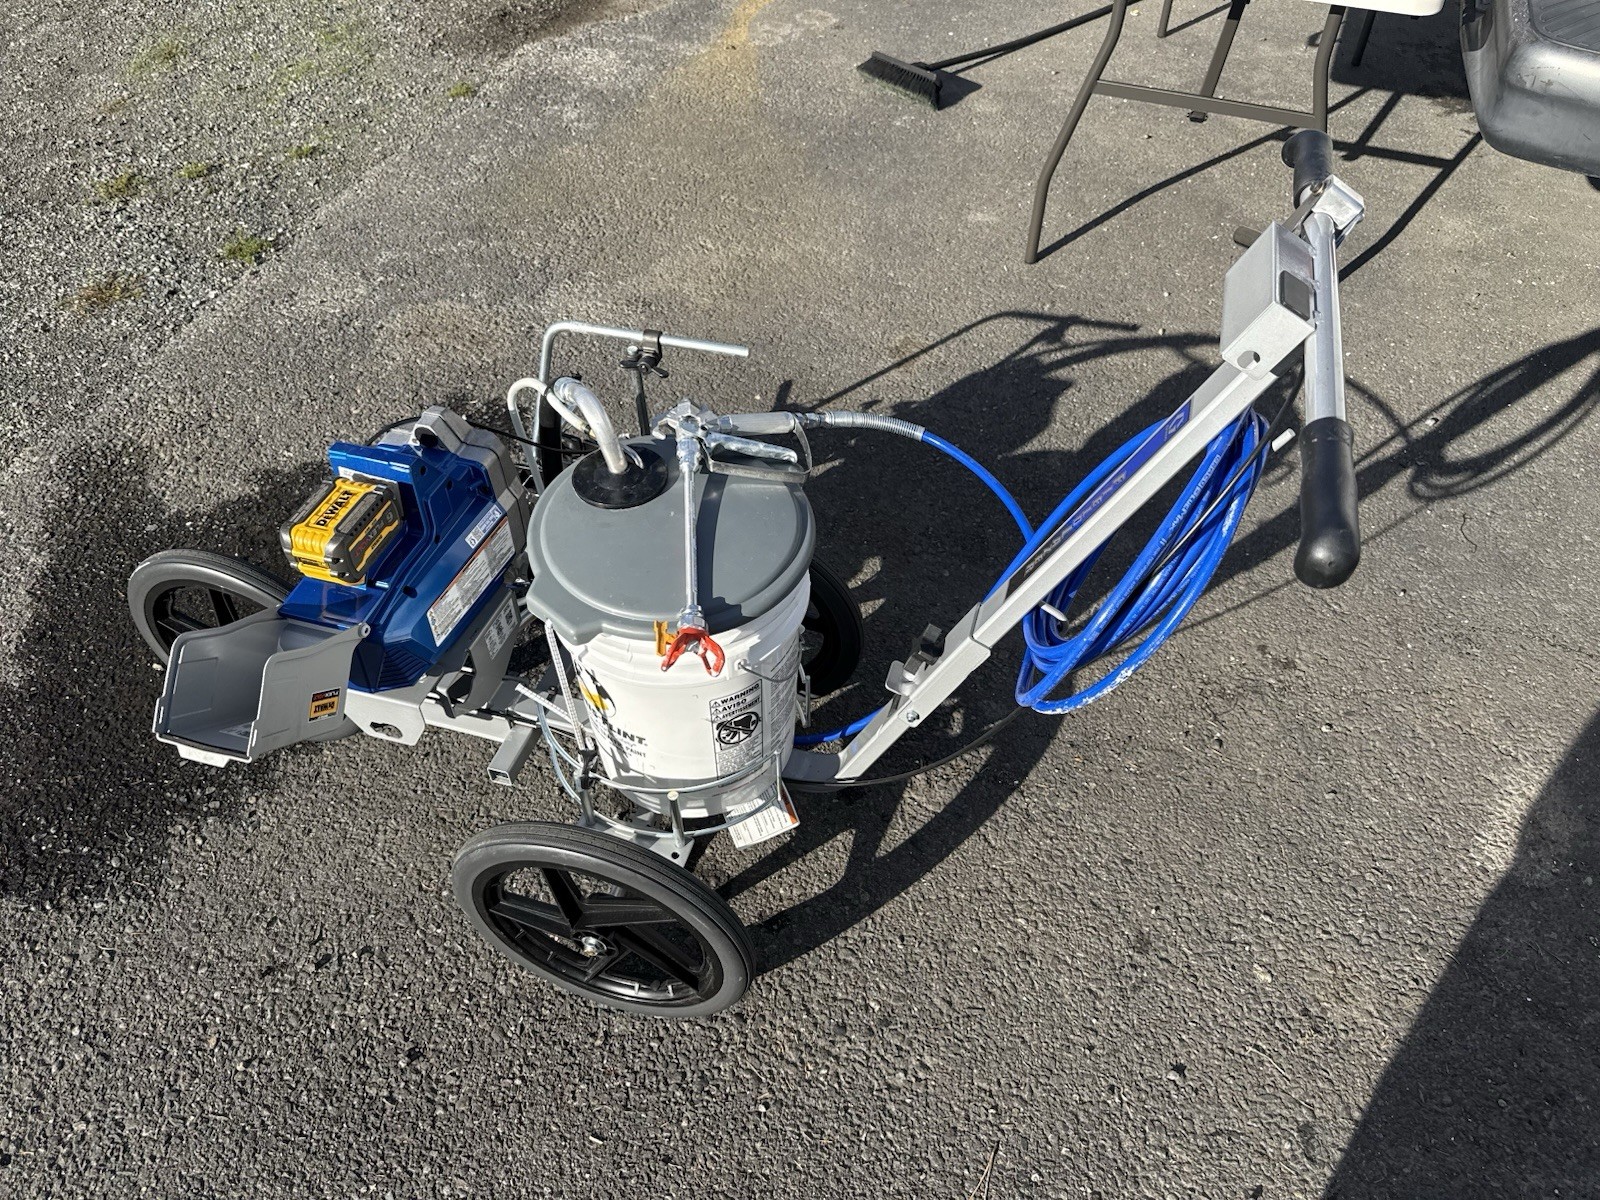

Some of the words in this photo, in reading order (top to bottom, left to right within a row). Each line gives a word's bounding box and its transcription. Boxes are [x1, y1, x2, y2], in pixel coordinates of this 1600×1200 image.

[316, 490, 353, 527] DEWALT
[721, 683, 760, 704] WARNING
[722, 698, 747, 711] AVISO
